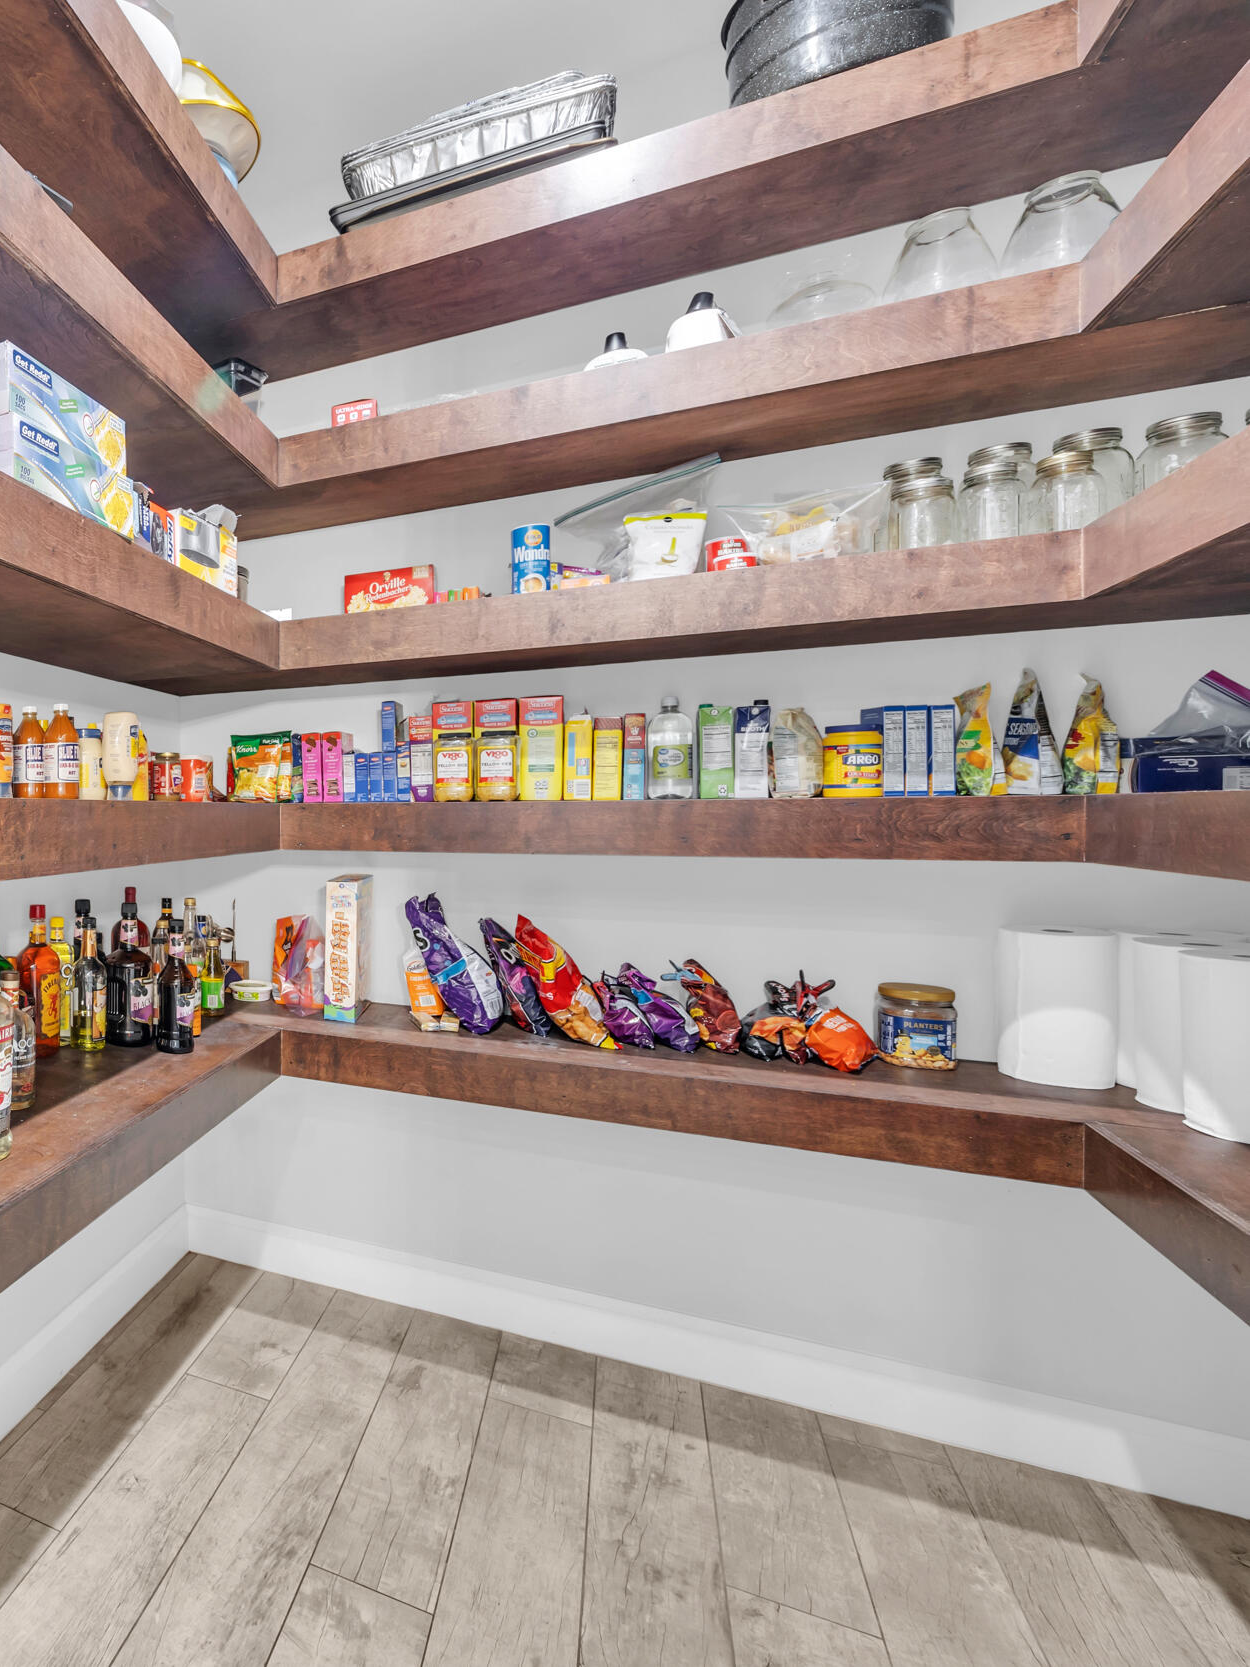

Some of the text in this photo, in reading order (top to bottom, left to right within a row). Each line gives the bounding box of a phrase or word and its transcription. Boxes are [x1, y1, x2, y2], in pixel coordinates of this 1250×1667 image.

[15, 354, 28, 369] Get
[21, 425, 36, 439] Get
[369, 577, 406, 594] Orville
[364, 585, 413, 603] Redenbacher's
[236, 745, 257, 753] Knorr
[846, 754, 878, 764] ARGO
[904, 1022, 944, 1031] PLANTERS
